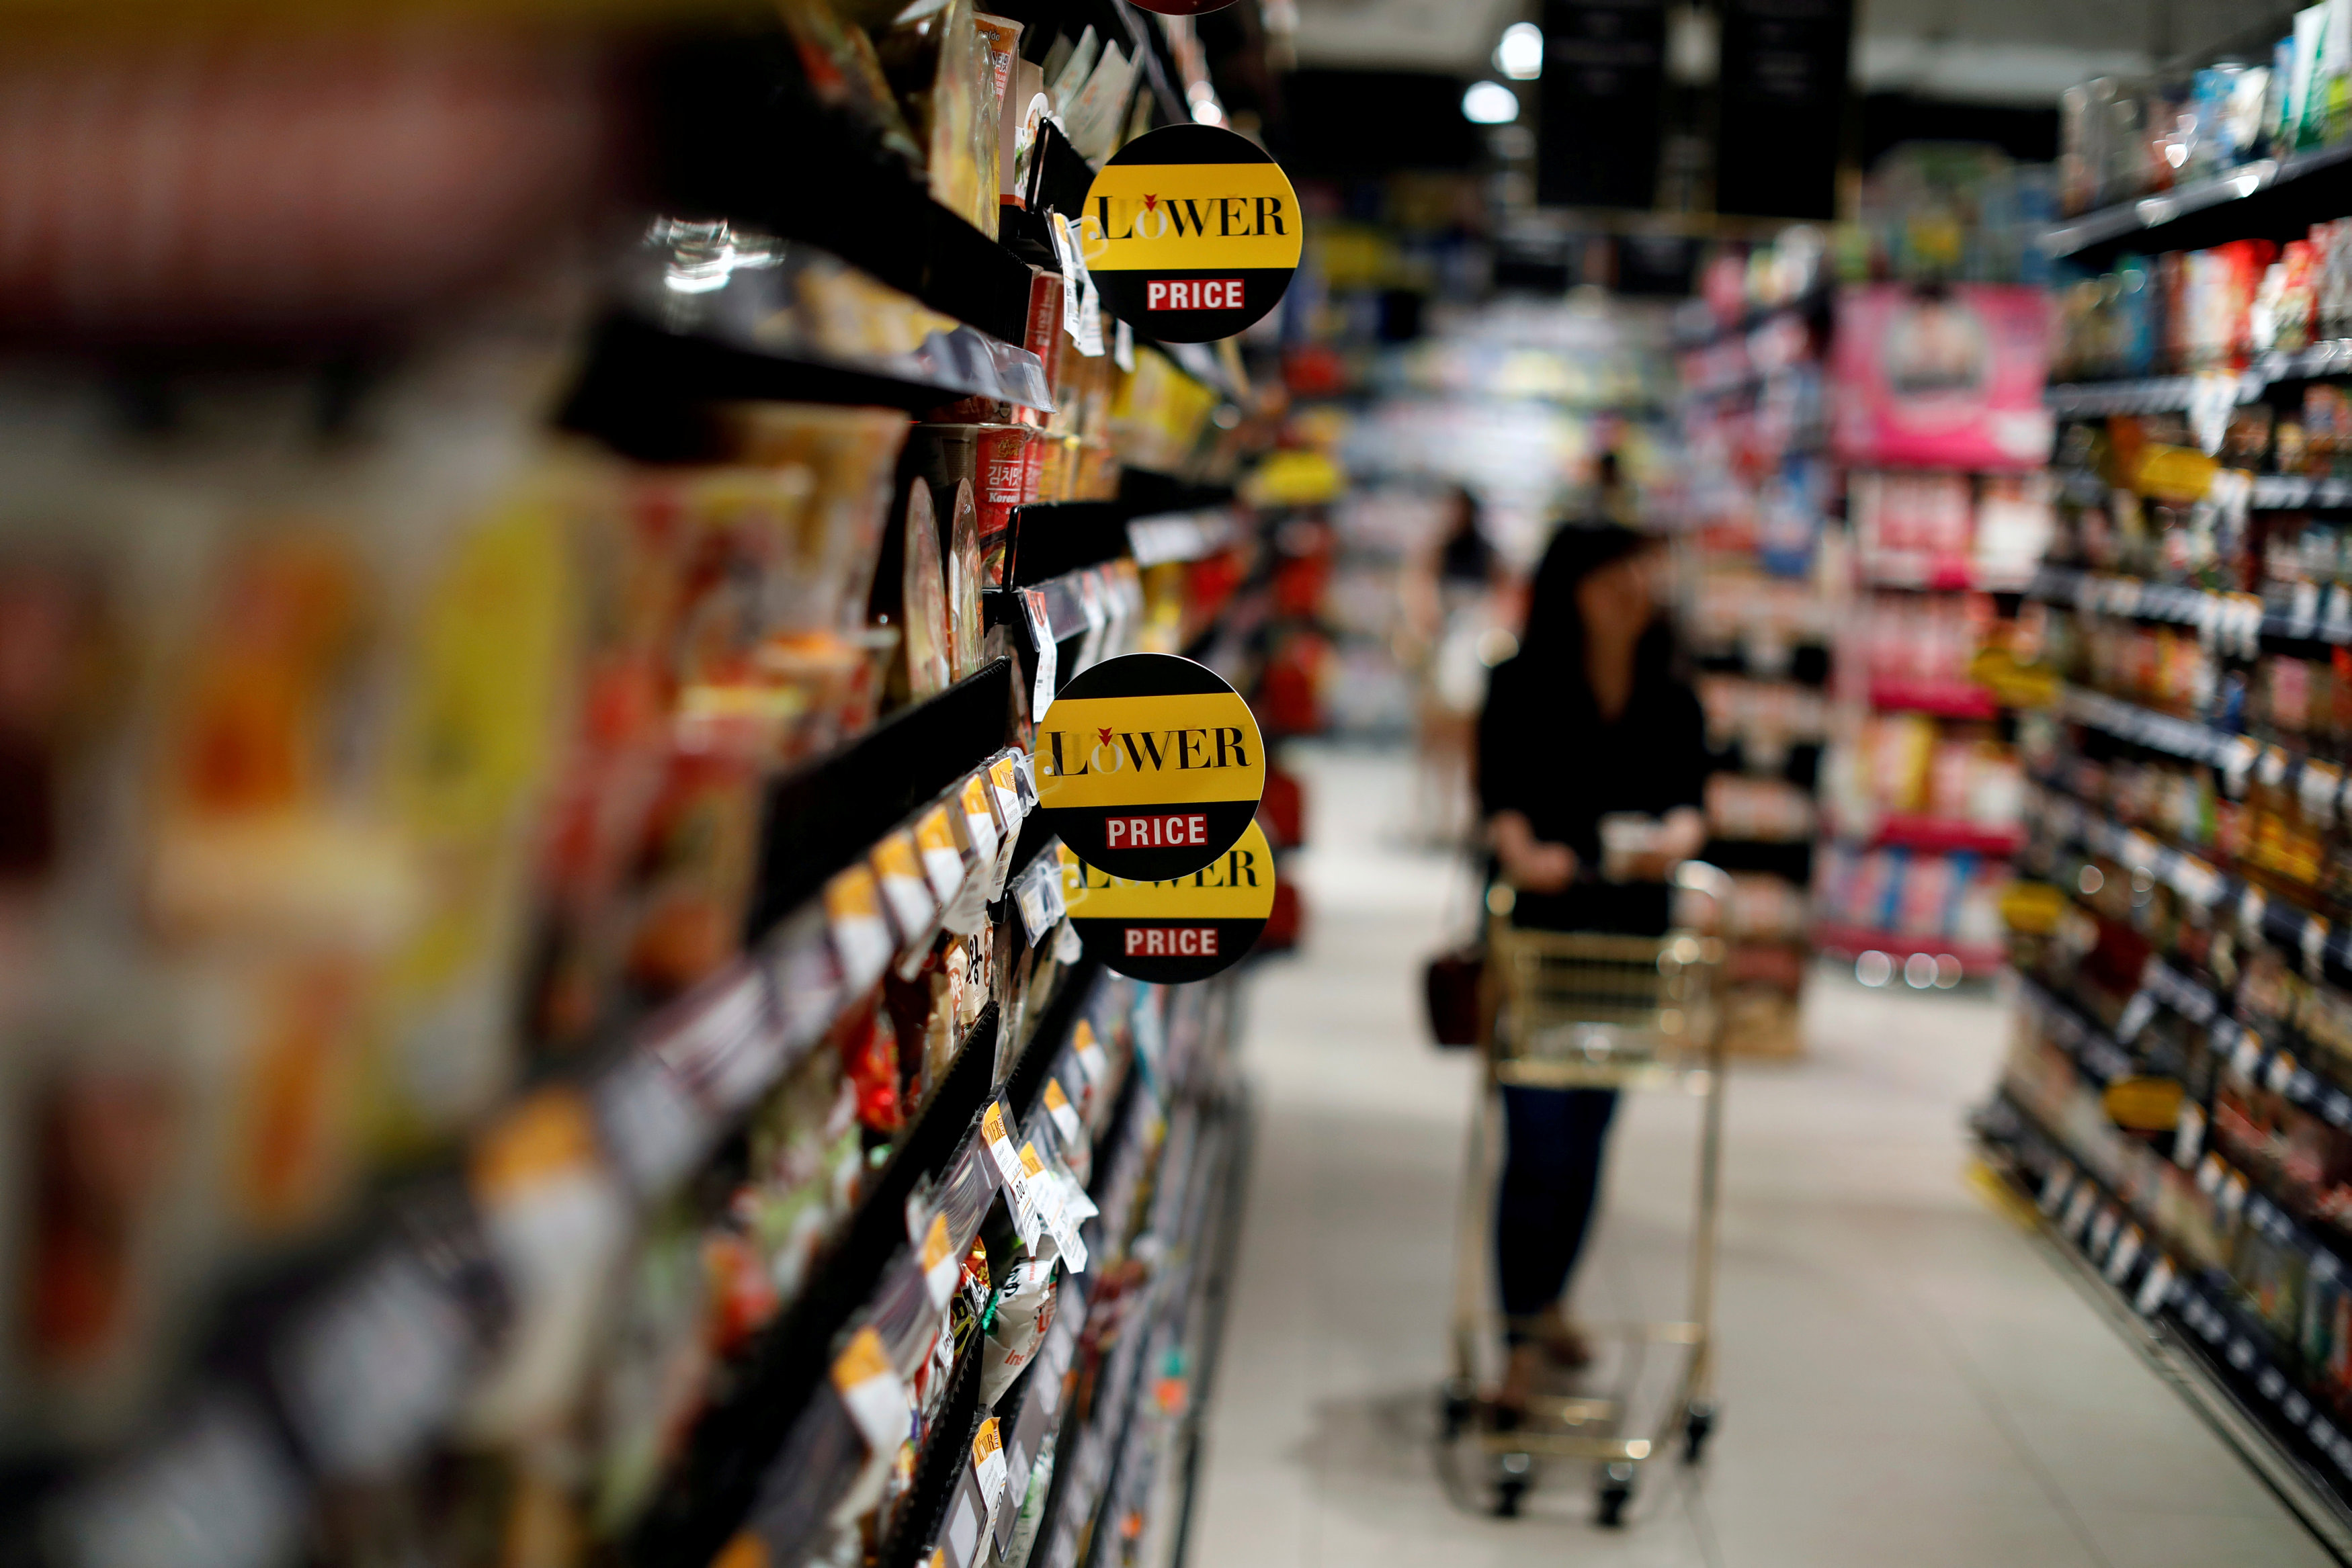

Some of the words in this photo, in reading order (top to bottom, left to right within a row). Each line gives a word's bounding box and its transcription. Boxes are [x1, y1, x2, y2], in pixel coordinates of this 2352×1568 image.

[1093, 195, 1289, 241] LOWER
[1148, 281, 1243, 309] PRICE
[1046, 726, 1251, 777] LOWER
[1108, 816, 1206, 846] PRICE
[1074, 850, 1261, 889] LER
[1126, 929, 1216, 955] PRICE
[974, 1433, 995, 1462] LOWR
